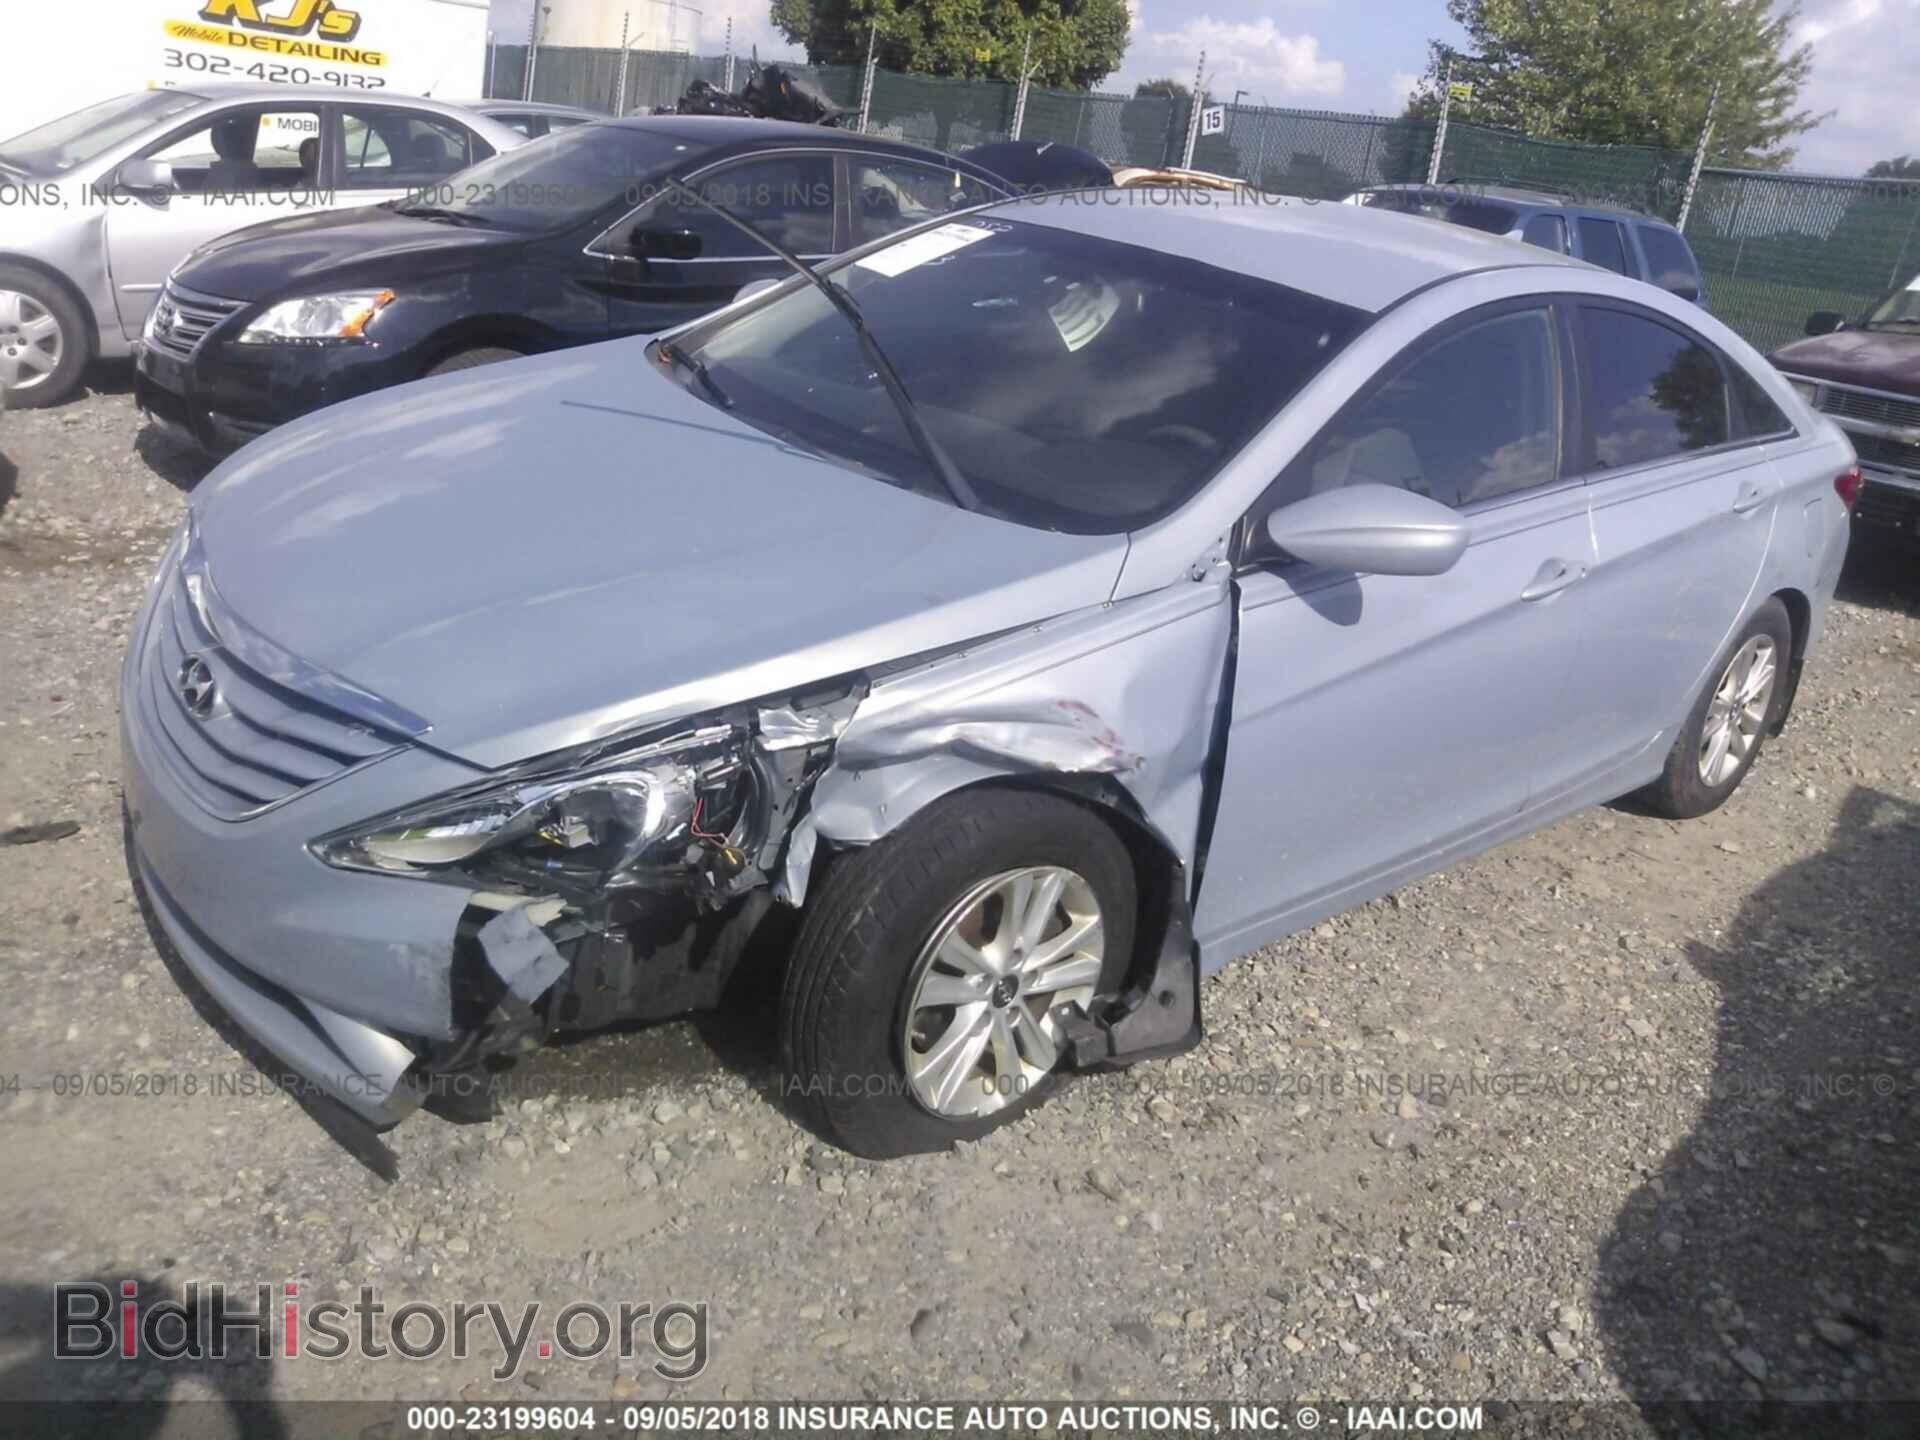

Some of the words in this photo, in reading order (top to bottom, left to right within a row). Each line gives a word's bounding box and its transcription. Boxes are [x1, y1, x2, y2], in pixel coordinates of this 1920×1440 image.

[173, 23, 223, 42] Mobile
[228, 31, 382, 66] DETAILING
[1206, 111, 1220, 130] 15
